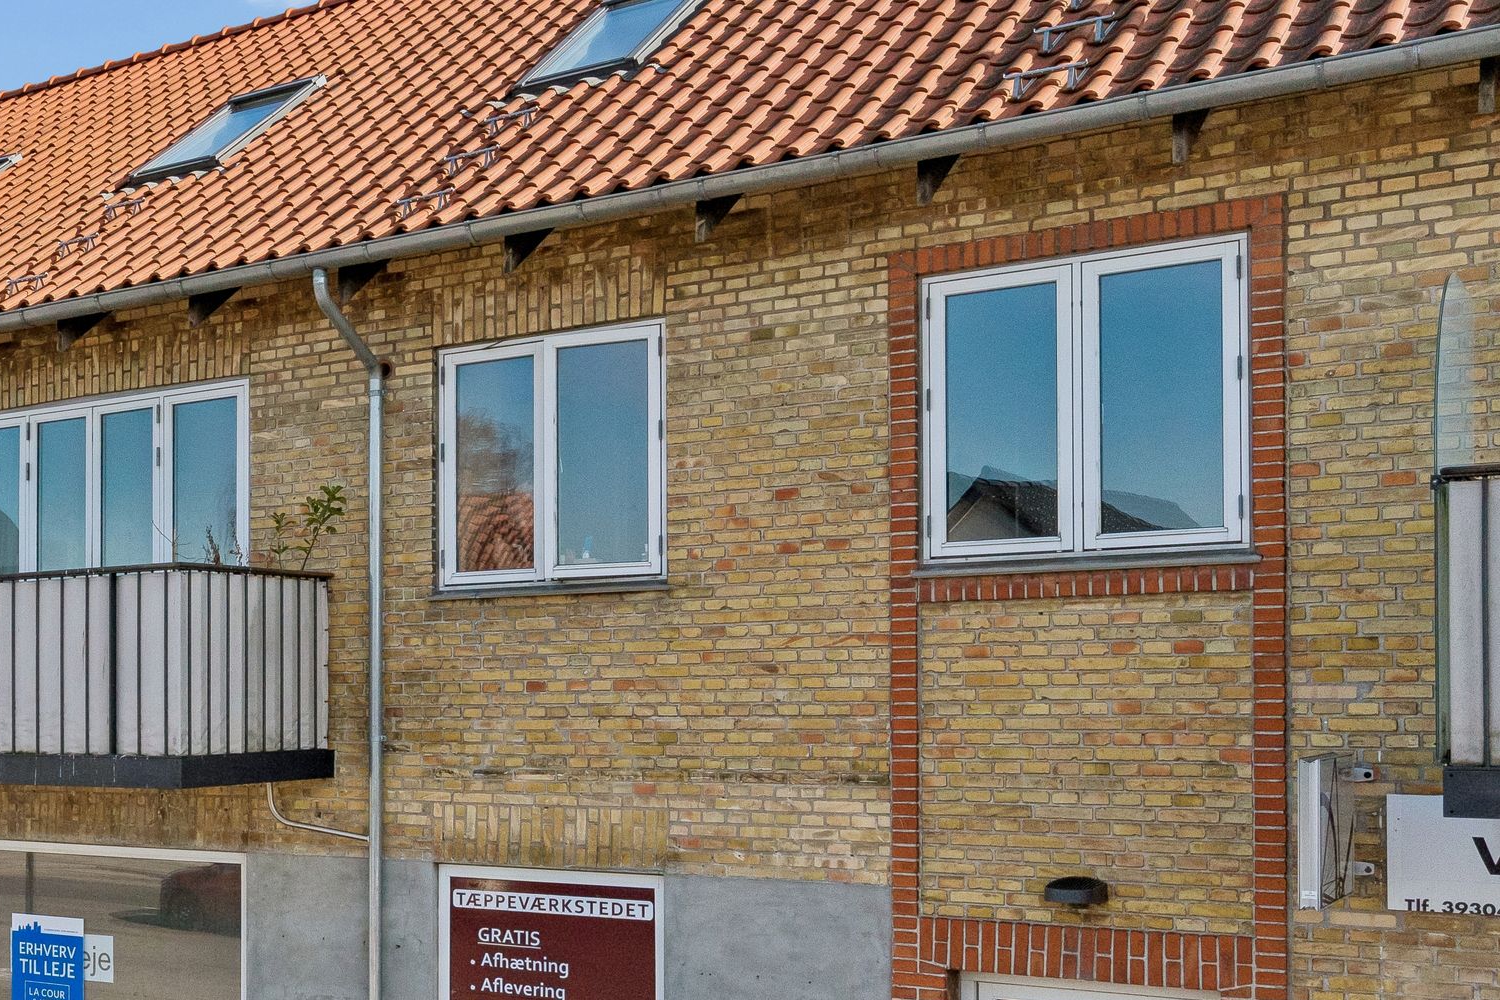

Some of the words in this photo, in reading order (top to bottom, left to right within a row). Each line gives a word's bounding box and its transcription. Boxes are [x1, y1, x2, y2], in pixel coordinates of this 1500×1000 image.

[455, 892, 649, 918] TÆPPEVÆRKSTEDET
[1404, 898, 1435, 913] Tlf.
[1441, 901, 1500, 916] 3930
[477, 927, 541, 946] GRATIS
[19, 941, 77, 960] ERHVERV
[19, 958, 40, 975] TIL
[43, 961, 76, 979] LEJE
[83, 945, 111, 977] eje
[480, 952, 569, 979] Afhætning
[28, 987, 39, 997] LA
[41, 988, 65, 1000] COUR
